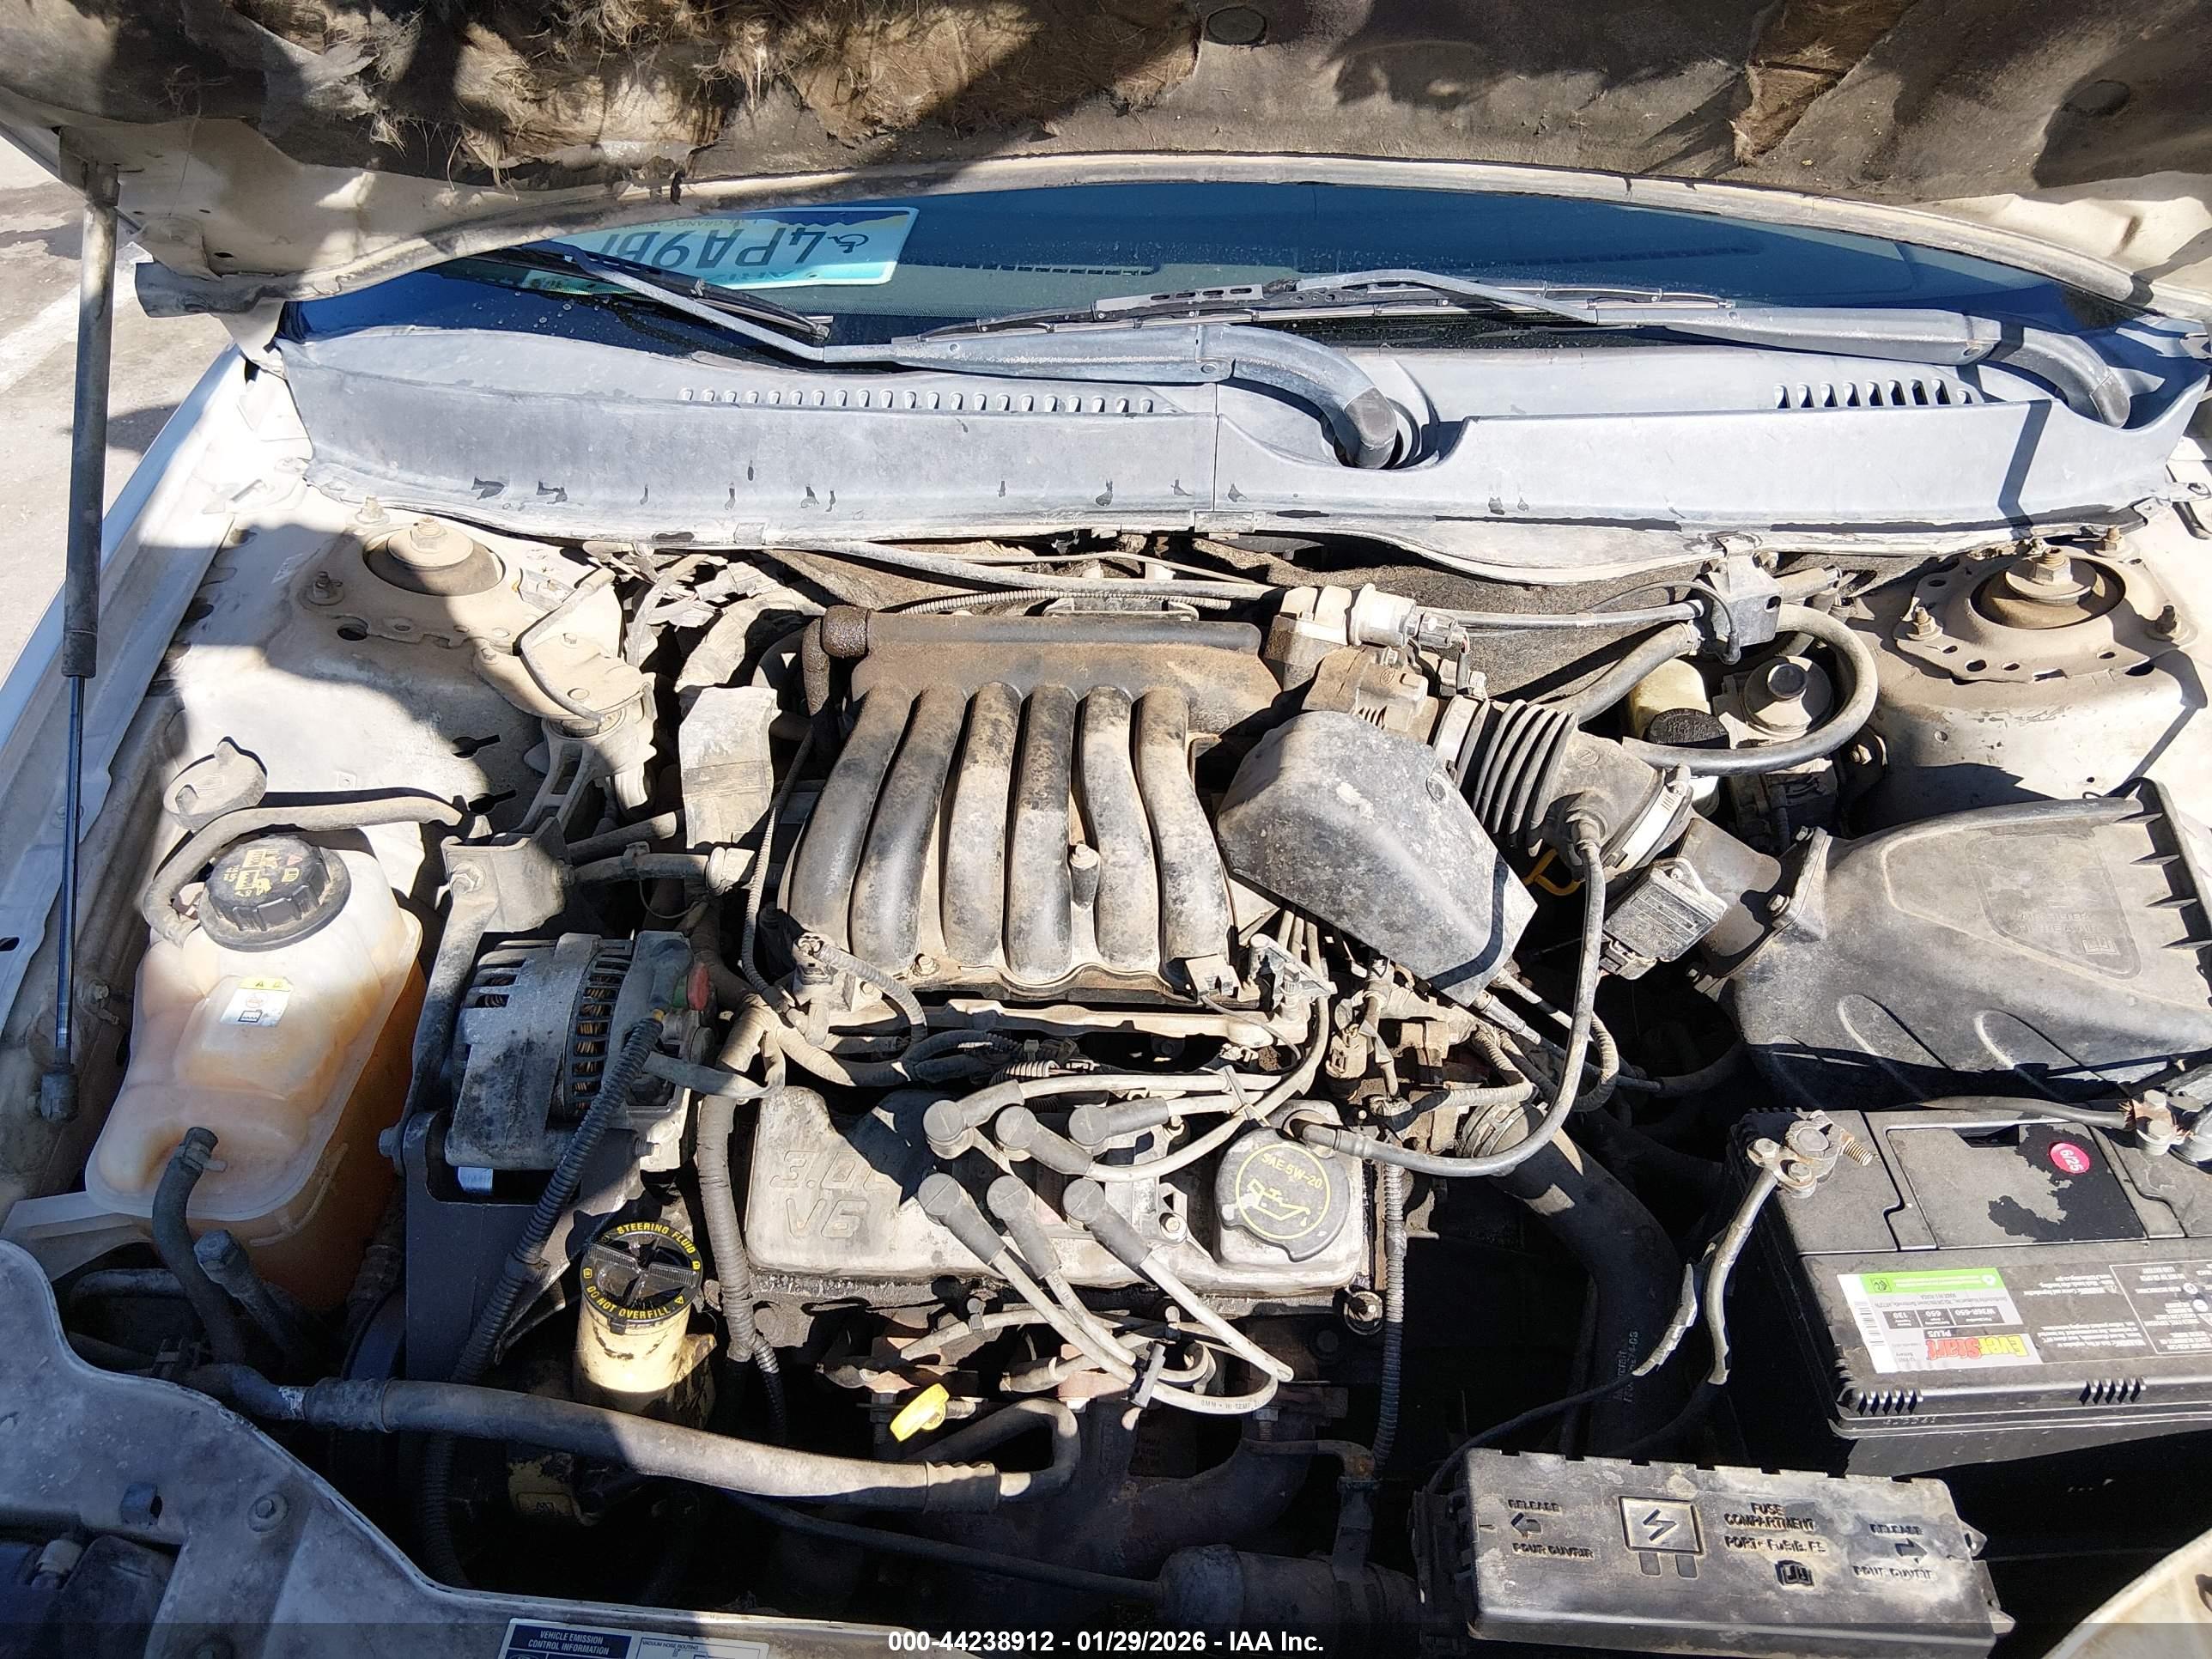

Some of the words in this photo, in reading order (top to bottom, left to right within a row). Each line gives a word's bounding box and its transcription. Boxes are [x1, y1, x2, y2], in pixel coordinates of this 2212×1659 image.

[2059, 1149, 2085, 1172] 6/25
[1261, 1152, 1285, 1172] SAE
[1284, 1163, 1323, 1190] 5W-20
[785, 1197, 870, 1241] V6
[616, 1222, 669, 1236] STEERING
[672, 1230, 696, 1255] FLUID
[586, 1285, 599, 1299] DO
[597, 1296, 617, 1313] NOT
[618, 1306, 672, 1320] OVERFILL
[1893, 1310, 1907, 1319] 130
[1925, 1310, 1942, 1318] 650
[1927, 1329, 1952, 1338] PLUS
[1925, 1334, 2029, 1361] EverStart
[1750, 1502, 1785, 1516] FUSE
[1723, 1513, 1815, 1531] COMPARTMENT
[540, 1630, 568, 1641] VEHICLE
[568, 1633, 604, 1644] EMISSION
[527, 1638, 560, 1650] CONTROL
[562, 1642, 610, 1656] INFORMATION
